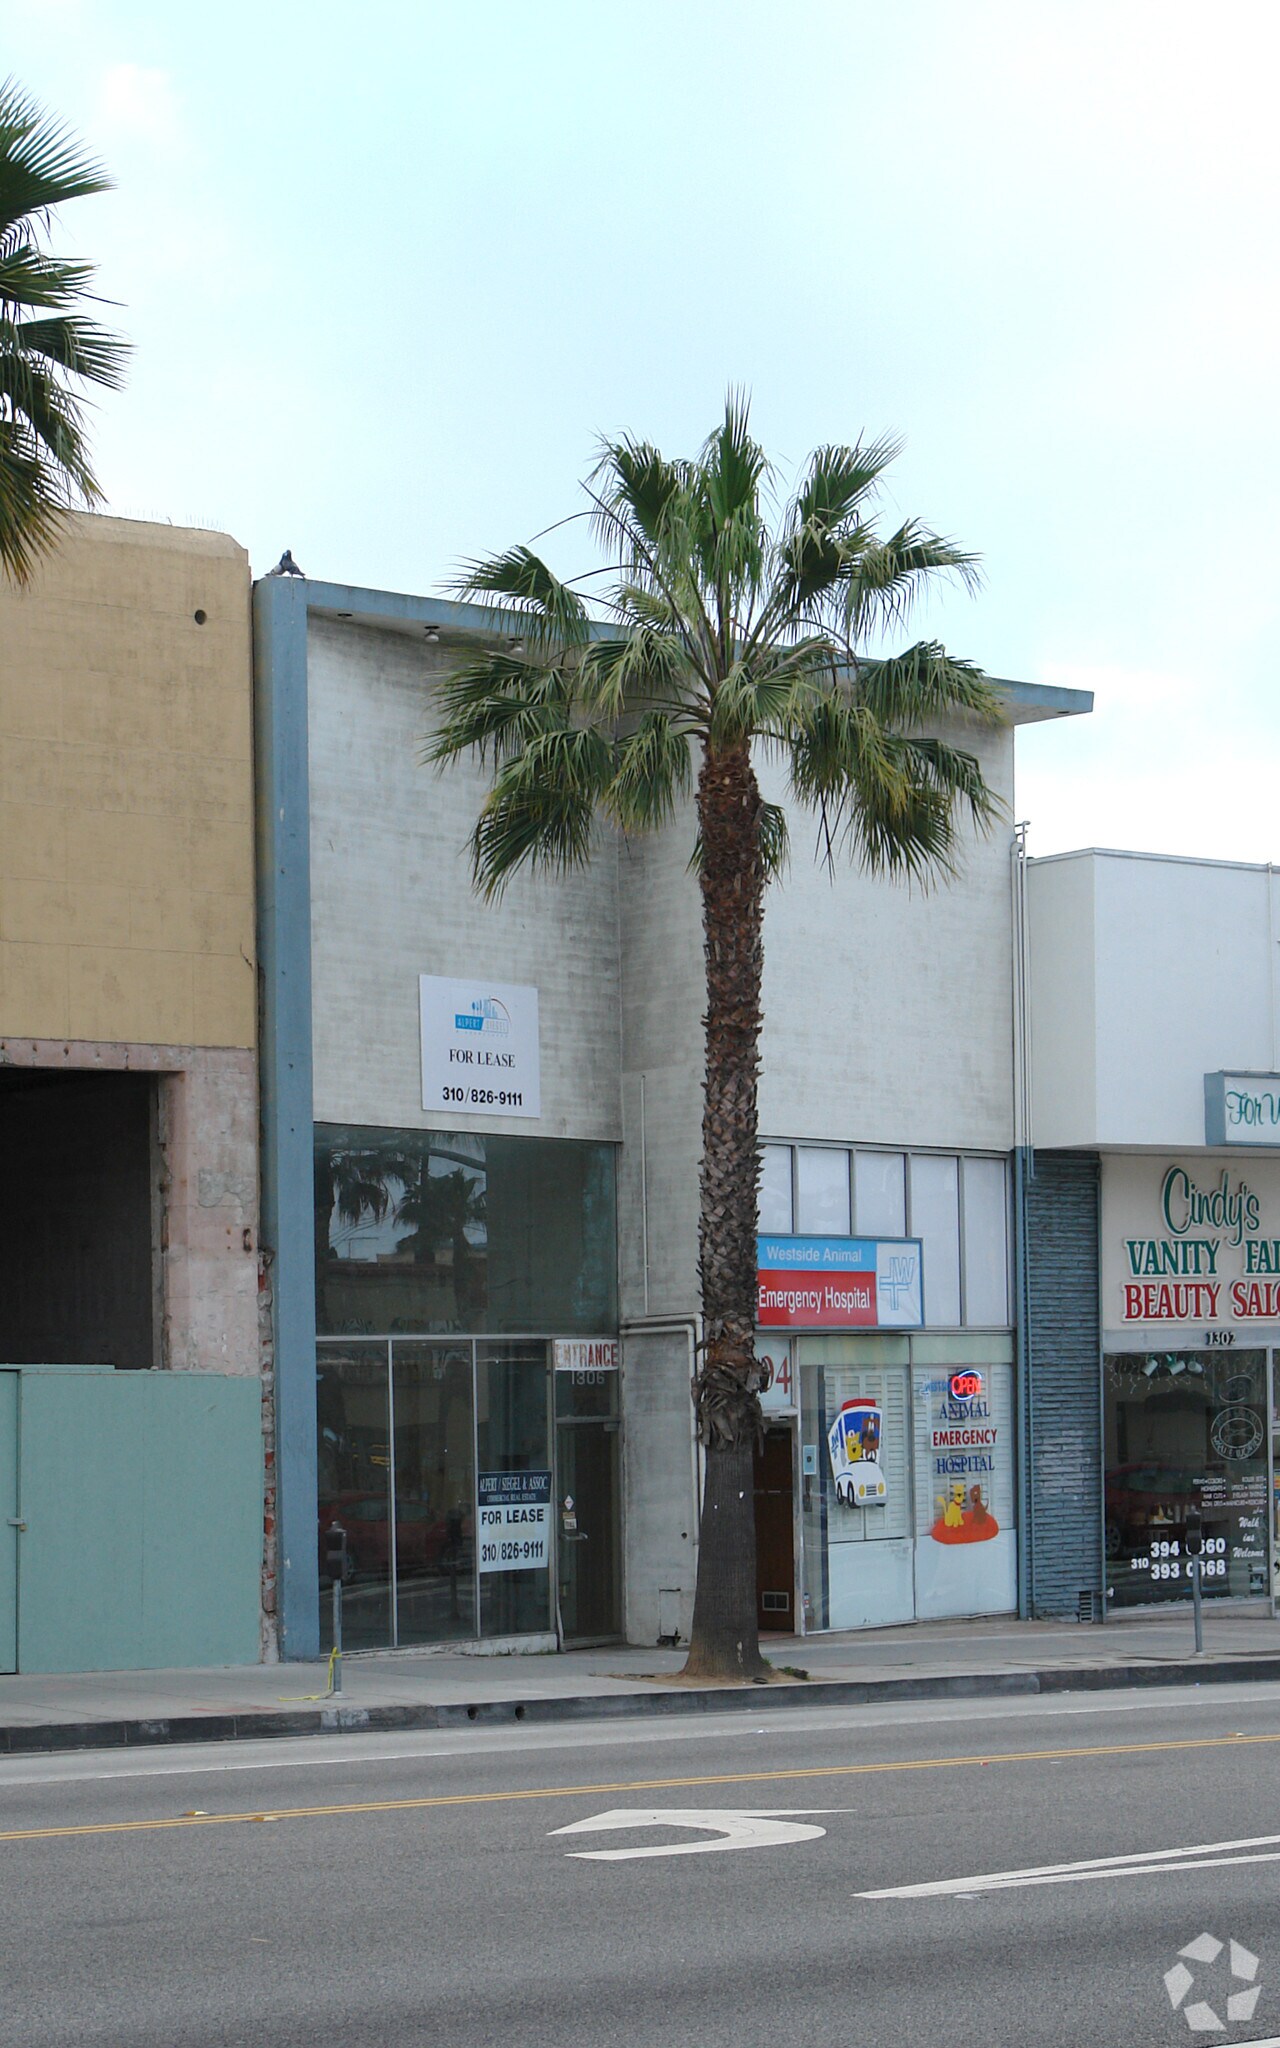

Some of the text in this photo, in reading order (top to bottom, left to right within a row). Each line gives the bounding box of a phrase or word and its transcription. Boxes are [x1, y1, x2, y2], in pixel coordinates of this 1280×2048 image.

[449, 1049, 516, 1068] FOR LEASE
[442, 1086, 523, 1106] 310/826-9111
[1226, 1091, 1264, 1126] For
[1163, 1167, 1260, 1247] Cindy's
[766, 1246, 862, 1263] Westside Animal
[1125, 1240, 1221, 1275] VANITY
[758, 1285, 871, 1314] Emergency Hospital
[1124, 1282, 1280, 1319] BEAUTY SAL
[1206, 1331, 1236, 1346] 1302
[553, 1343, 618, 1368] ENTRANCE
[571, 1371, 605, 1385] 1306
[951, 1375, 981, 1395] OPEN
[939, 1402, 990, 1419] ANIMAL
[933, 1429, 998, 1446] EMERGENCY
[936, 1455, 995, 1474] HOSPITAL
[481, 1508, 544, 1525] FOR LEASE
[1238, 1516, 1259, 1528] Walk
[482, 1541, 543, 1562] 310/826-9111
[1150, 1541, 1180, 1558] 394
[1232, 1547, 1265, 1558] Welcome
[1130, 1558, 1149, 1569] 310
[1150, 1562, 1180, 1580] 393
